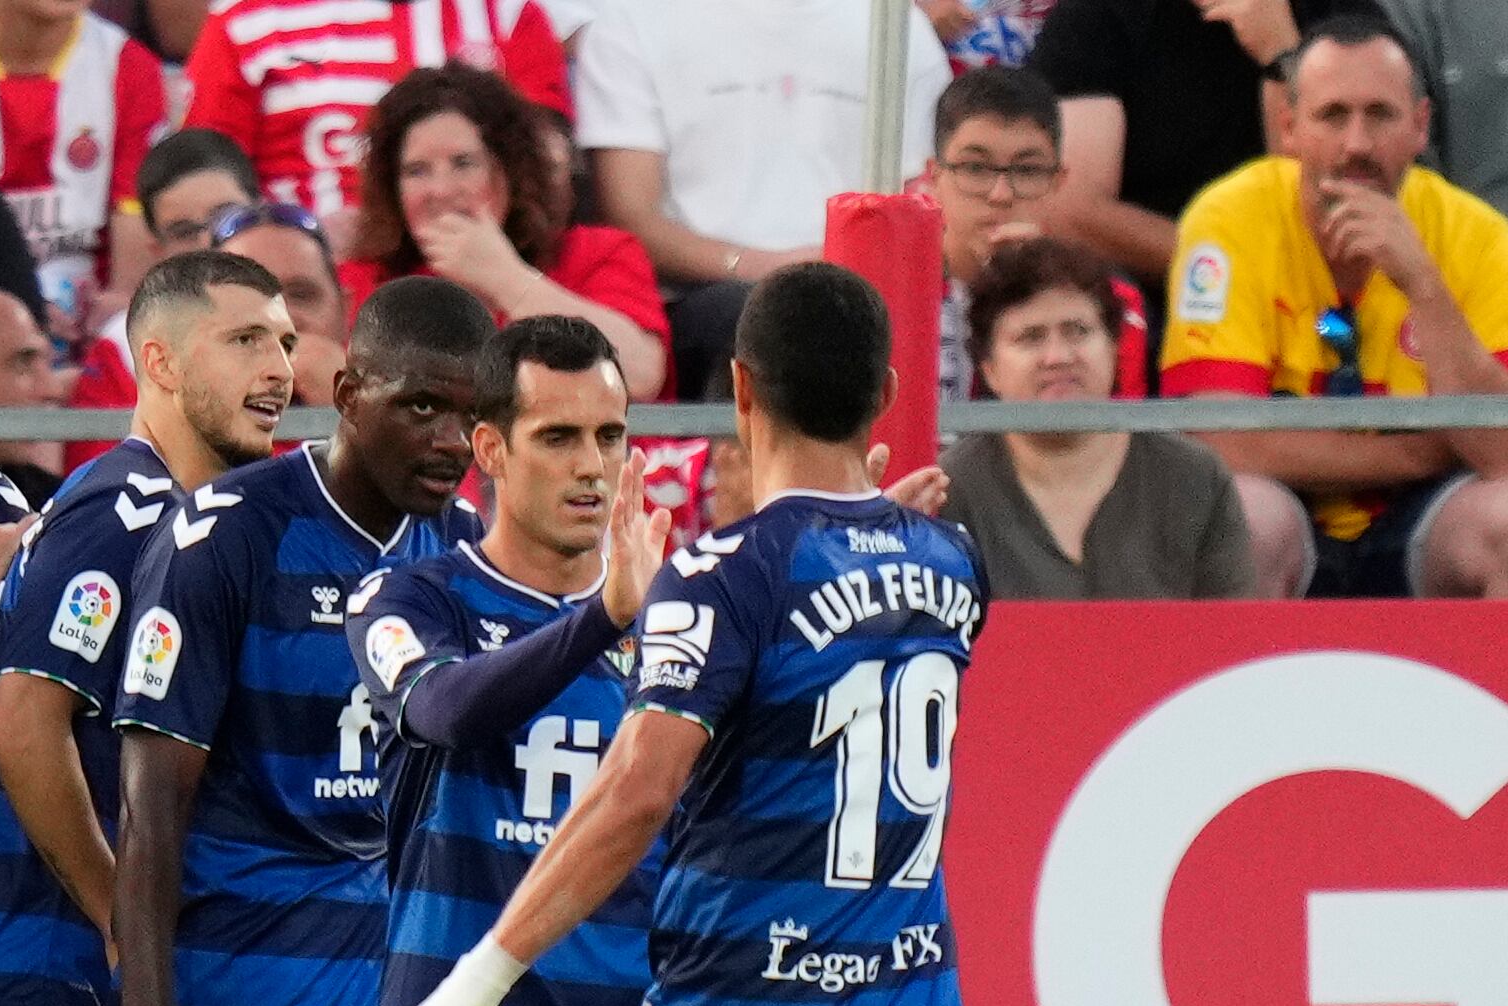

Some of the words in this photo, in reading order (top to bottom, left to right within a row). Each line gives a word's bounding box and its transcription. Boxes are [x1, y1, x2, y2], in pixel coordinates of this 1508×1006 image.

[790, 569, 884, 653] LUIZ
[58, 623, 98, 650] LaLiga
[314, 776, 380, 799] netw
[809, 650, 960, 890] 19
[891, 922, 942, 971] FX
